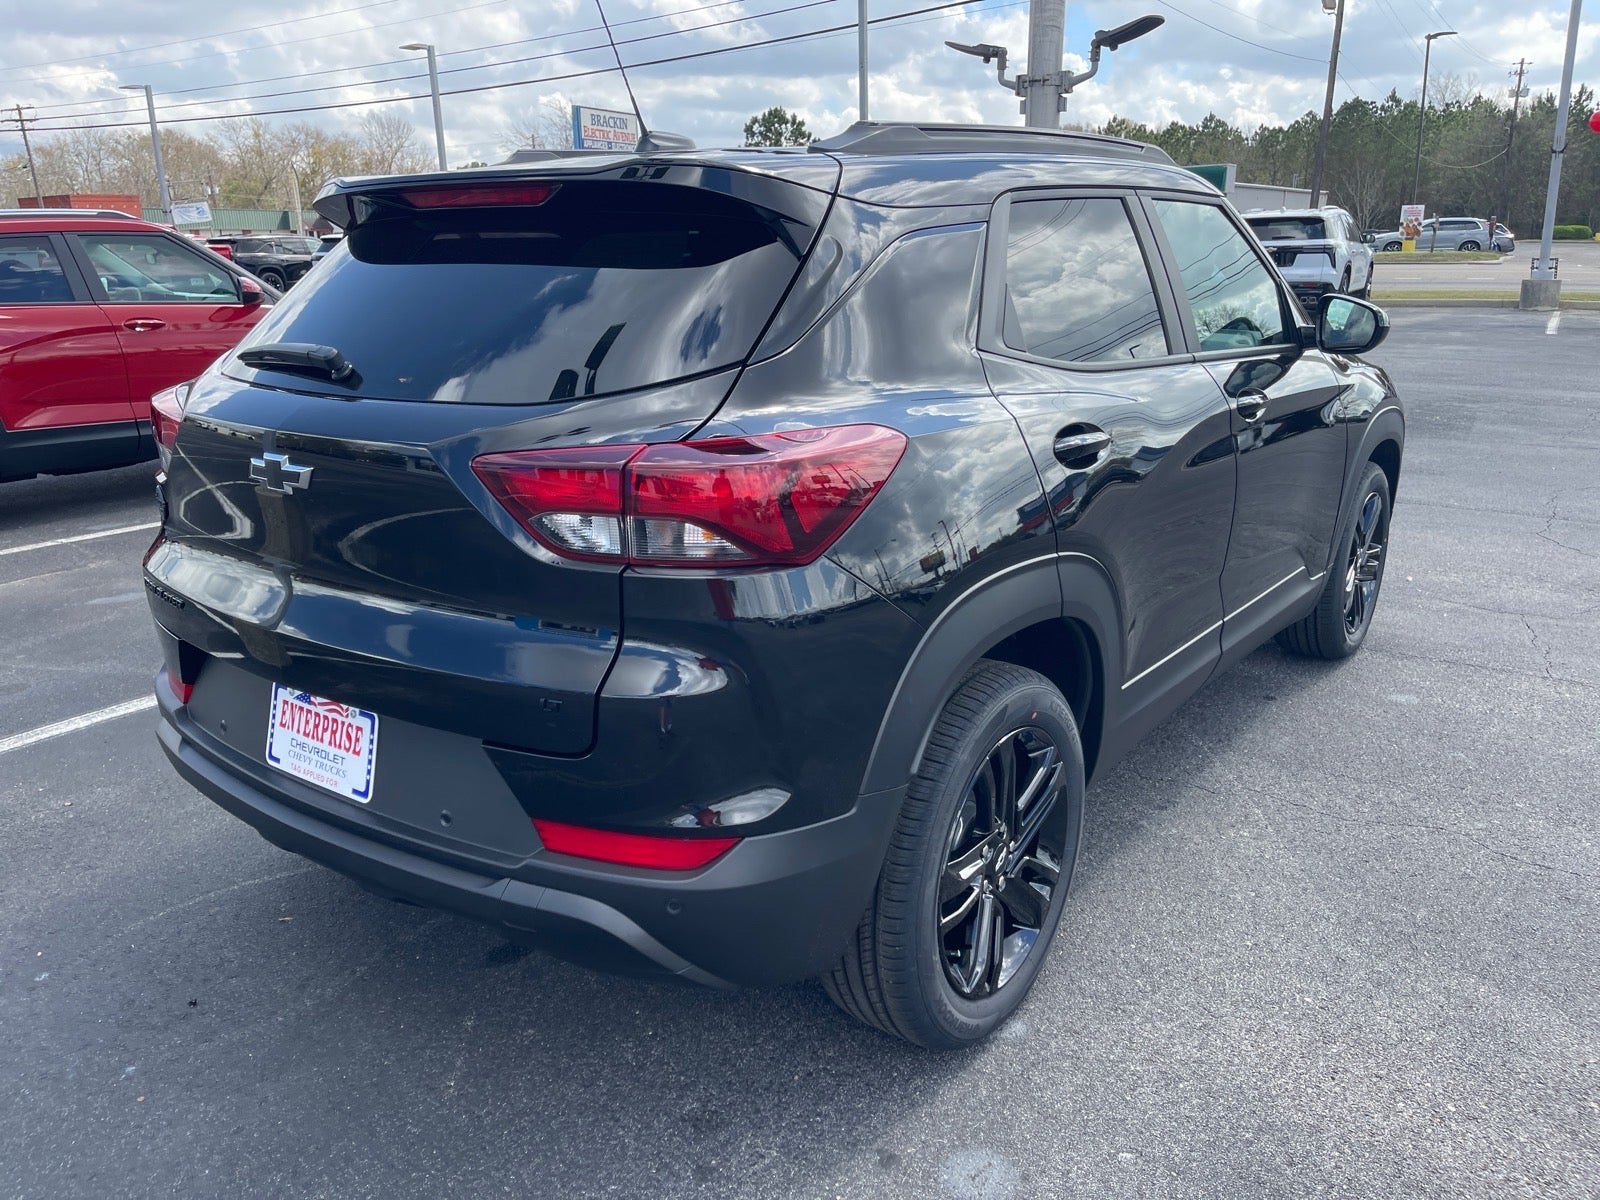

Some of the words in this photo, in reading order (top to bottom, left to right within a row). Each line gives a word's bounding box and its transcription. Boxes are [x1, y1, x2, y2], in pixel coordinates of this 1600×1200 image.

[583, 125, 611, 140] ELECTRIC
[613, 130, 636, 143] AVENUE
[590, 113, 628, 130] BRACKIN
[279, 699, 364, 757] ENTERPRISE
[287, 749, 314, 767] CHEVY
[315, 759, 347, 778] TRUCKS
[290, 737, 346, 766] CHEVROLET
[290, 763, 302, 773] TAG
[303, 769, 325, 784] APPLIED
[326, 778, 338, 787] FOR
